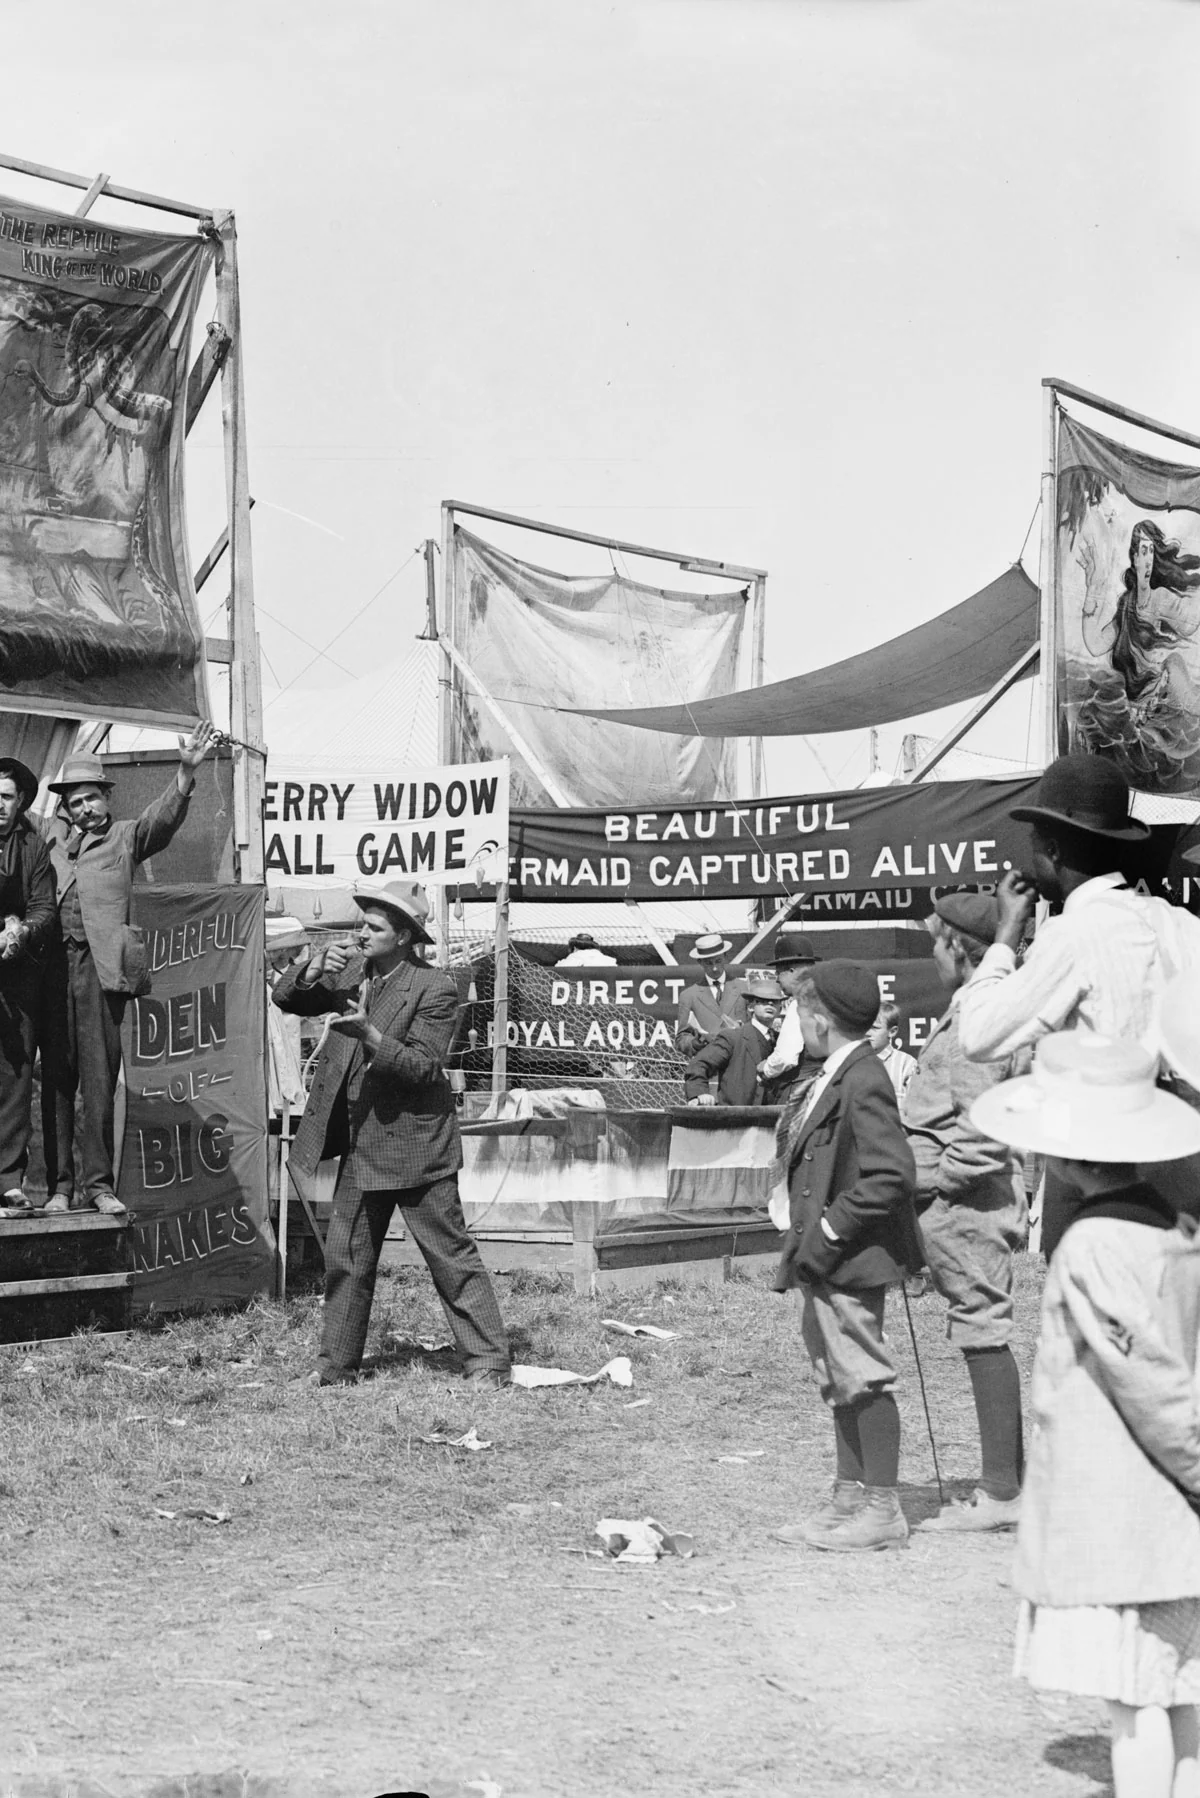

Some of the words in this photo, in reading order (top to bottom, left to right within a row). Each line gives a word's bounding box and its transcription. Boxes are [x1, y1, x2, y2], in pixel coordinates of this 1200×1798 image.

[40, 223, 121, 255] REPTILE
[21, 249, 63, 280] KING
[65, 260, 77, 276] OF
[79, 263, 97, 277] THE
[264, 782, 355, 822] ERRY
[373, 776, 498, 821] WIDOW
[604, 802, 850, 842] BEAUTIFUL
[264, 833, 335, 876] ALL
[356, 828, 467, 876] GAME
[649, 848, 851, 887] CAPTURED
[871, 839, 1013, 878] ALIVE.
[551, 979, 685, 1006] DIRECT
[131, 981, 227, 1067] DEN
[583, 1018, 679, 1050] AQUA
[138, 1113, 235, 1190] BIG
[132, 1205, 257, 1275] NAKES
